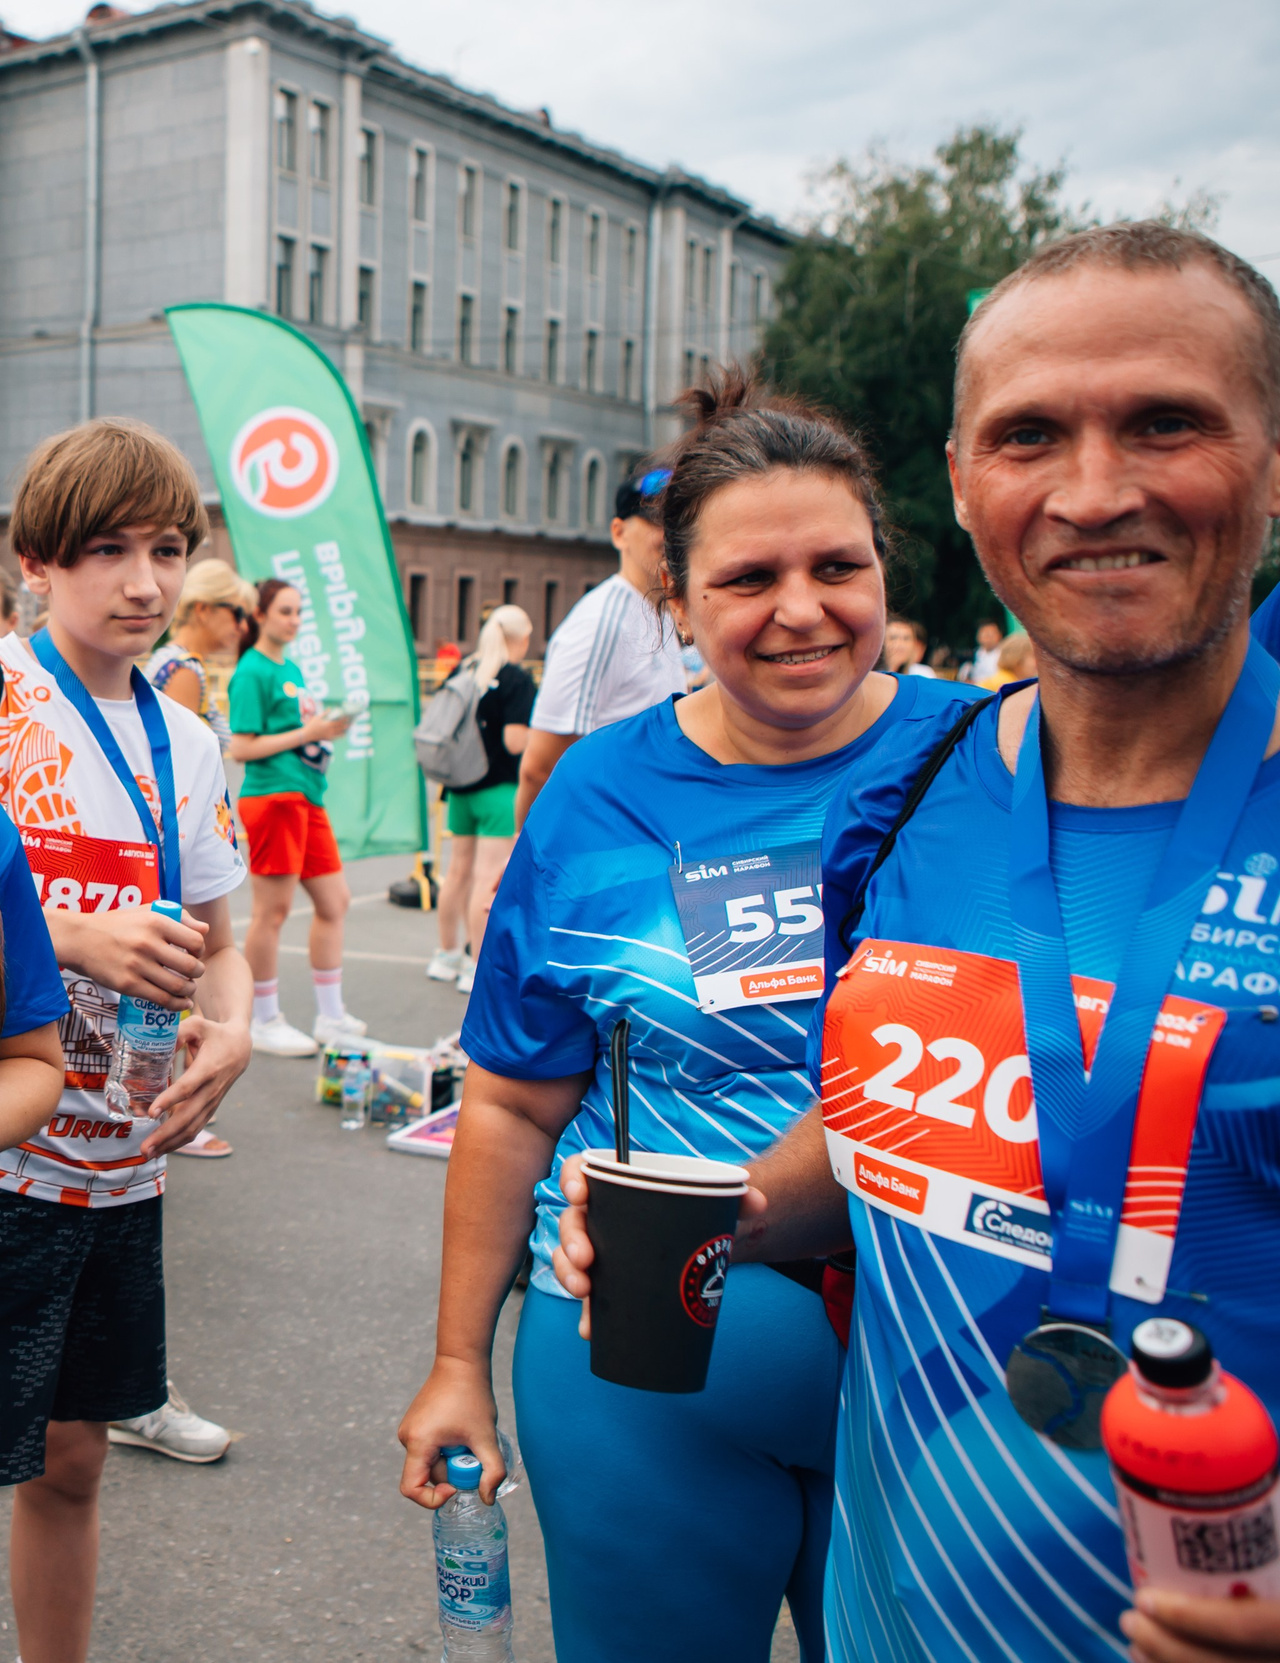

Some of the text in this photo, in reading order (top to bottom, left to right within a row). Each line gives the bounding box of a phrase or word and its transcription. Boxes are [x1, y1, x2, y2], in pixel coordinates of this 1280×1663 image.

[731, 854, 769, 866] СИБИРСКИЙ
[733, 862, 771, 873] МАРАФОН
[724, 883, 824, 943] 55
[1190, 922, 1280, 954] БИРС
[914, 959, 958, 973] СИБИРСКИЙ
[748, 973, 818, 993] Альфа Банк
[909, 971, 954, 987] МАРАФОН
[145, 1012, 177, 1027] БОР
[863, 1023, 1039, 1144] 220
[858, 1163, 921, 1200] Альфа Банк
